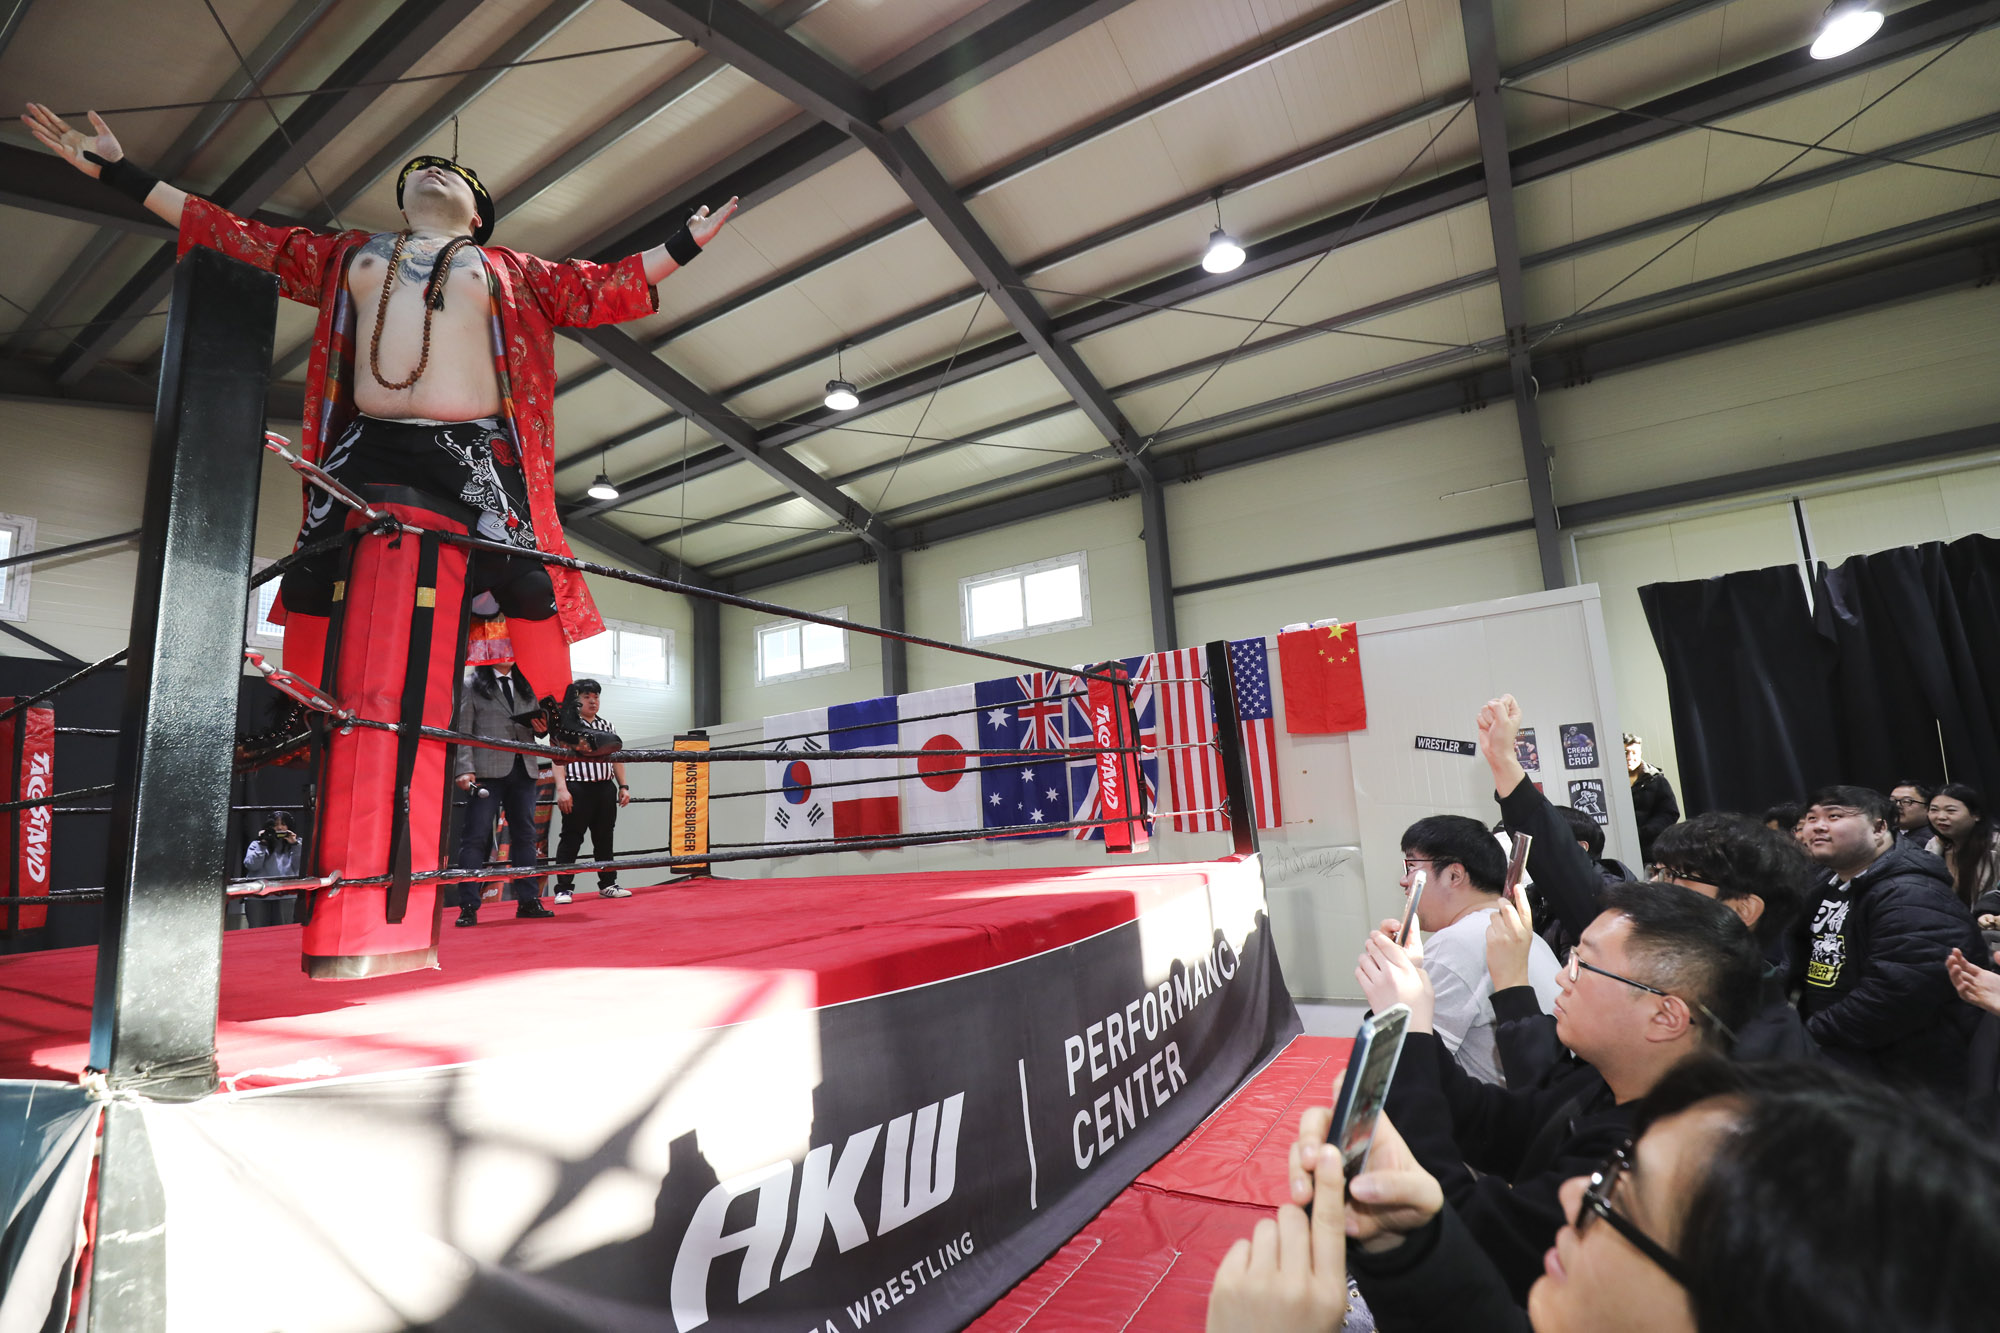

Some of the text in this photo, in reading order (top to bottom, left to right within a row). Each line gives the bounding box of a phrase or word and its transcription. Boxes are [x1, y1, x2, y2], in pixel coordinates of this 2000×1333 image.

[1417, 736, 1460, 753] WRESTLER
[1567, 746, 1593, 754] CREAM
[1568, 757, 1594, 766] CROP
[1570, 781, 1602, 793] NO PAIN
[684, 761, 698, 852] NOSTRESSBURGER
[1594, 815, 1608, 823] AIN
[1073, 1041, 1188, 1170] CENTER
[670, 1091, 965, 1333] AKW
[846, 1231, 975, 1330] WRESTLING
